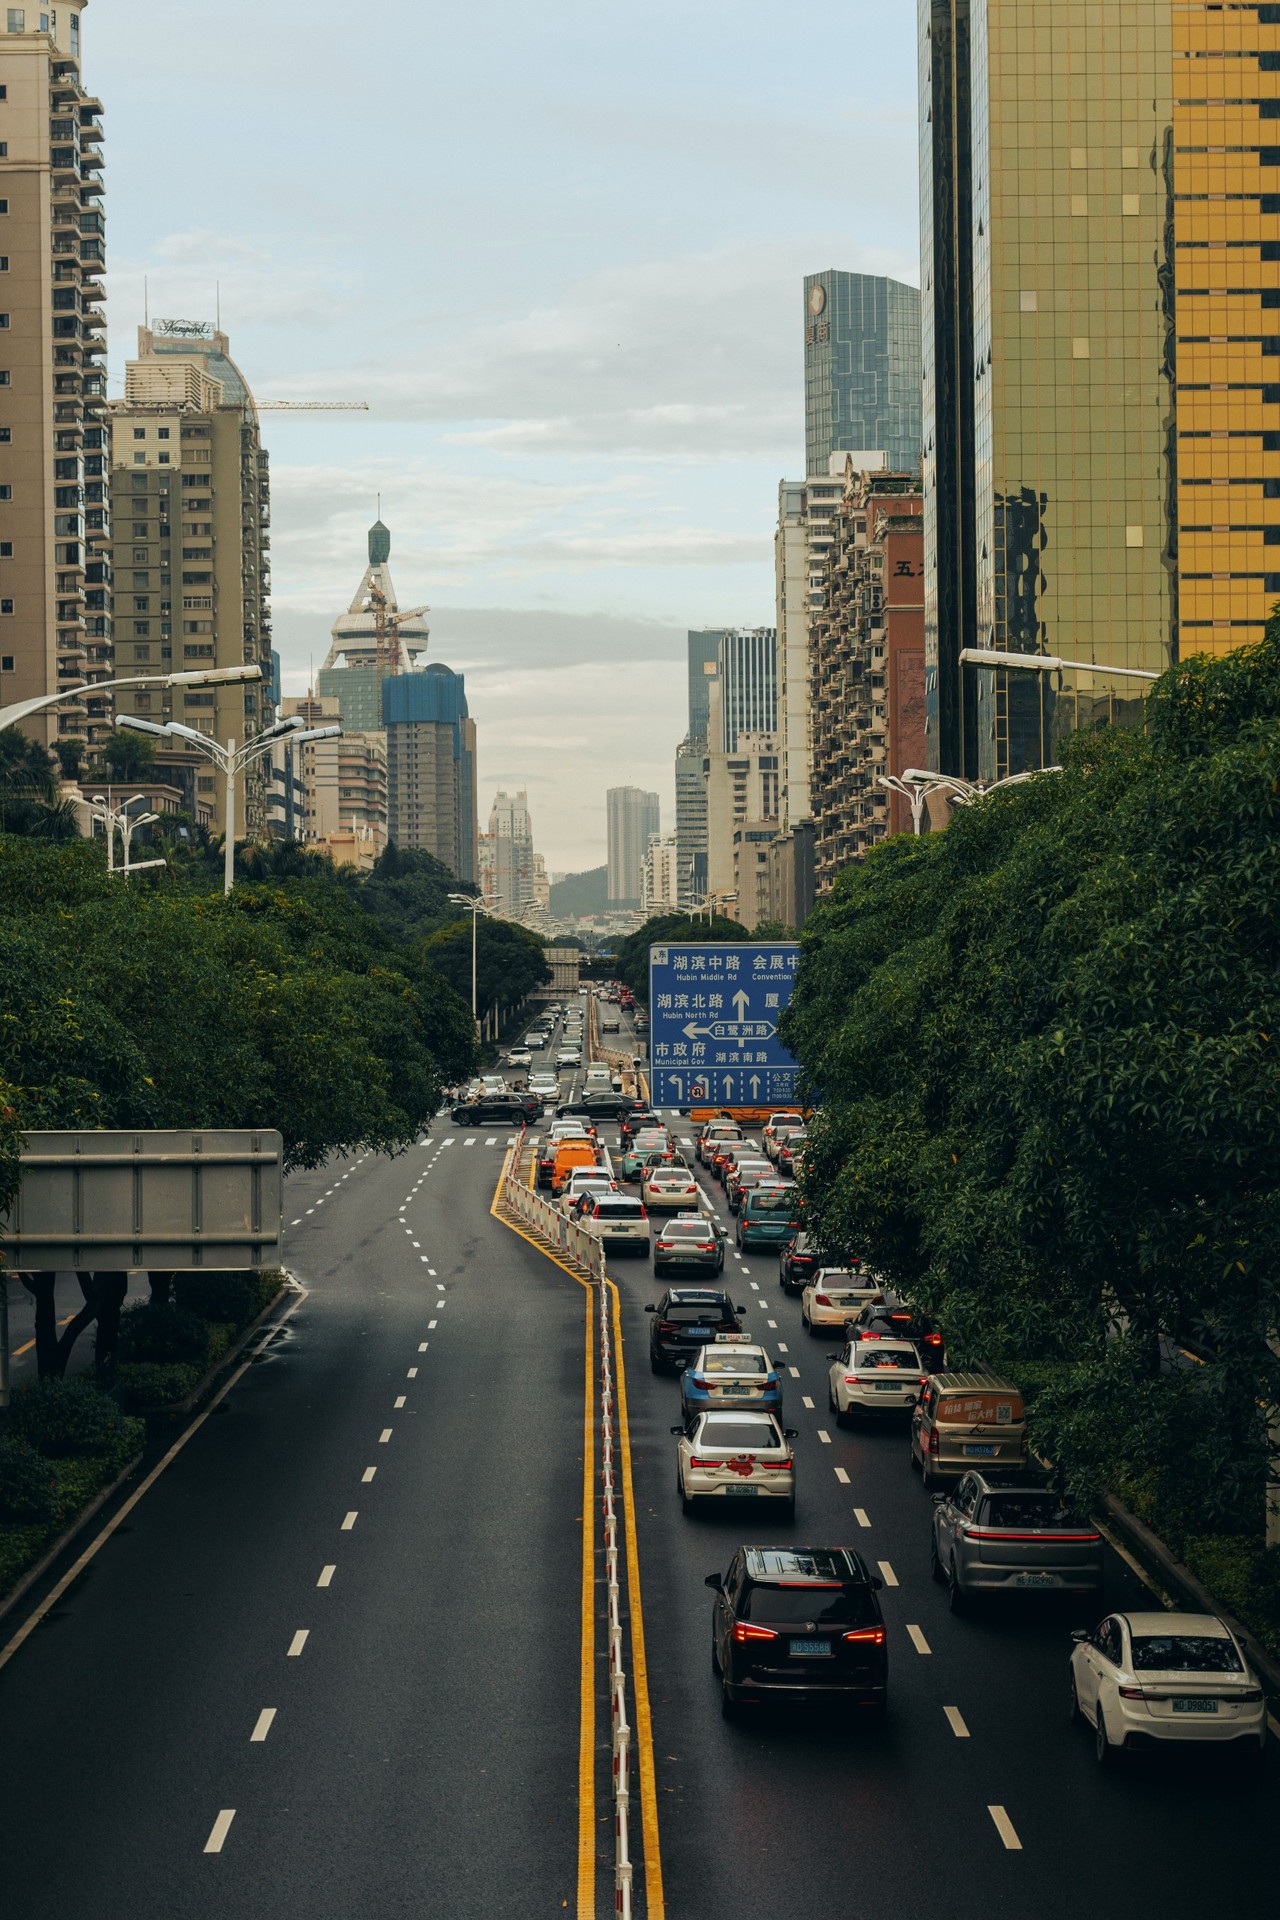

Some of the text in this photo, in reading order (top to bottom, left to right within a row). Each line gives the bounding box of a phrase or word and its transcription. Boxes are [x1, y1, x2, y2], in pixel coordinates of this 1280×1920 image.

[673, 955, 741, 970] 湖滨中路
[752, 973, 792, 981] Convention
[657, 993, 723, 1009] 湖滨北路
[662, 1011, 719, 1019] Hubin North Rd
[714, 1024, 768, 1036] 白鹭洲路
[655, 1042, 706, 1057] 市政府
[655, 1057, 689, 1066] Municipal
[715, 1051, 768, 1063] 湖滨南路
[772, 1073, 791, 1082] 公交
